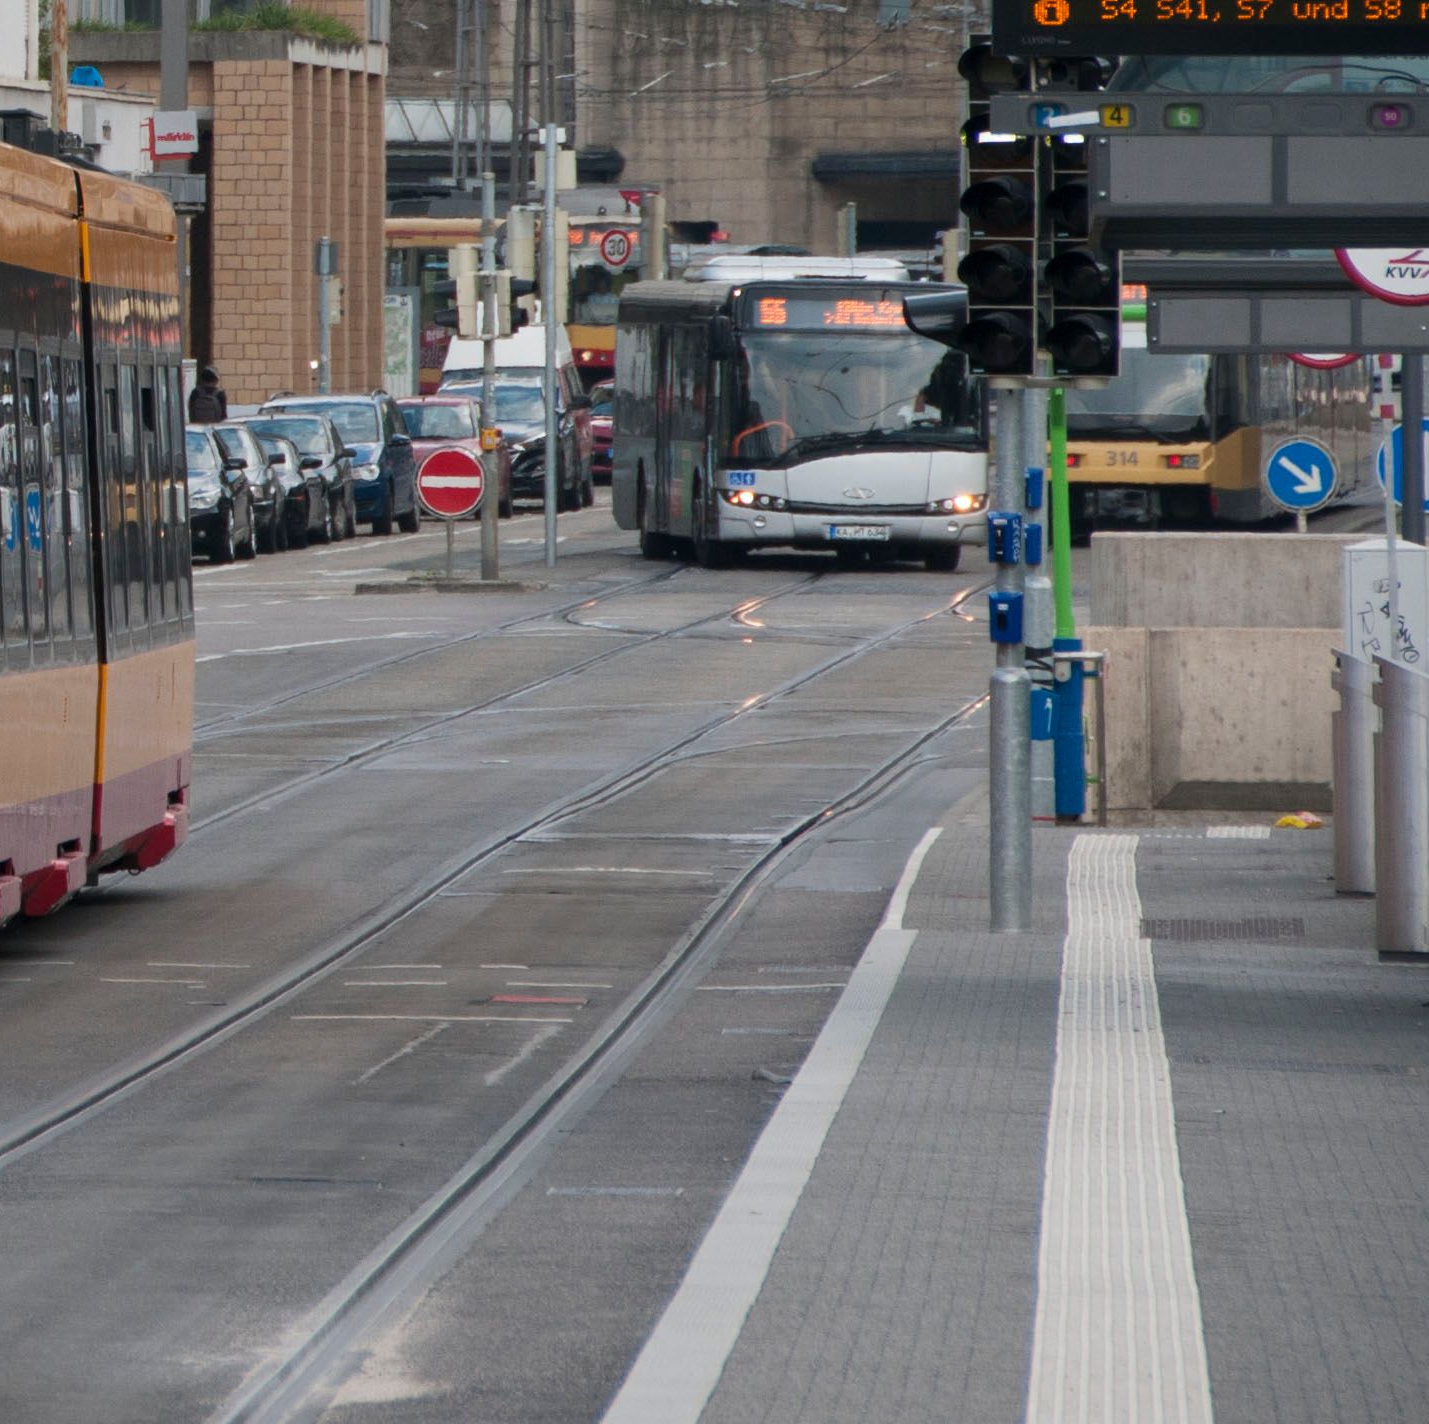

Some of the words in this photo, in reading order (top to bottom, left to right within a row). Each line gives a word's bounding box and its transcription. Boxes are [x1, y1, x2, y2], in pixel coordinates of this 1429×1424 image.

[1109, 105, 1124, 124] 4
[1177, 107, 1191, 125] 6
[607, 238, 626, 257] 30
[1385, 266, 1421, 279] KVV
[1106, 450, 1139, 467] 314
